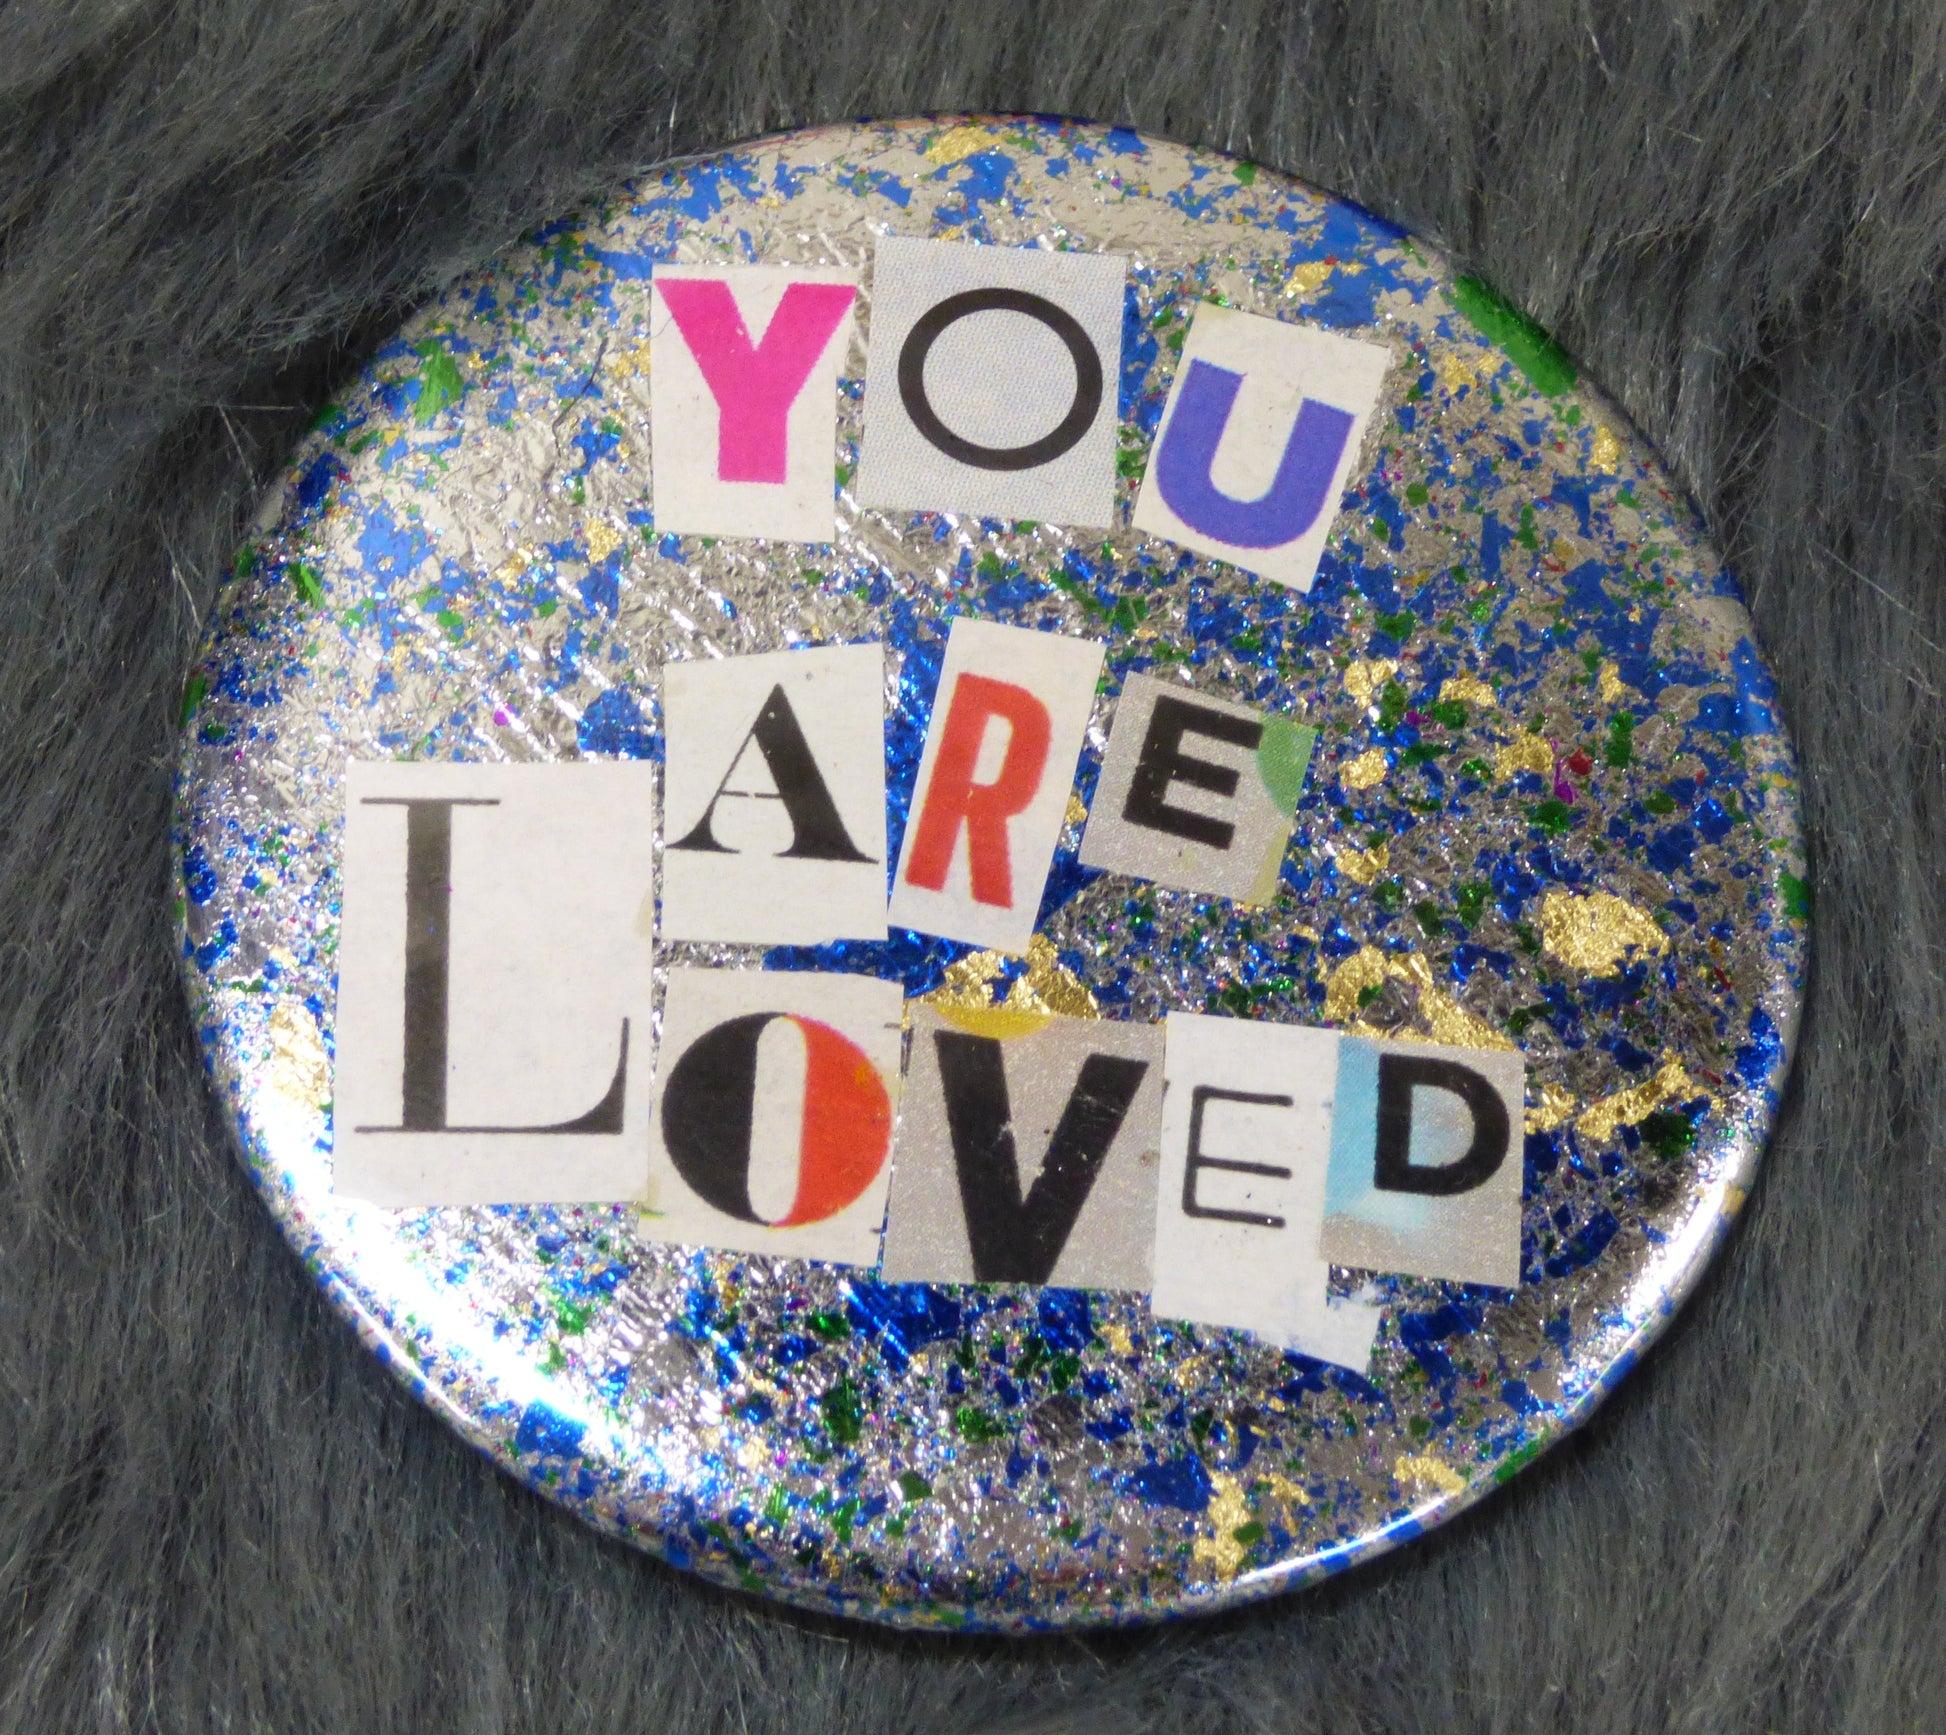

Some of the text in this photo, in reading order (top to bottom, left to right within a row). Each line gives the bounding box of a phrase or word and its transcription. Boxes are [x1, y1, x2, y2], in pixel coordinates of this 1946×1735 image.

[655, 280, 1357, 549] YOU
[667, 672, 1263, 908] ARE
[355, 797, 1511, 1284] LOVED
